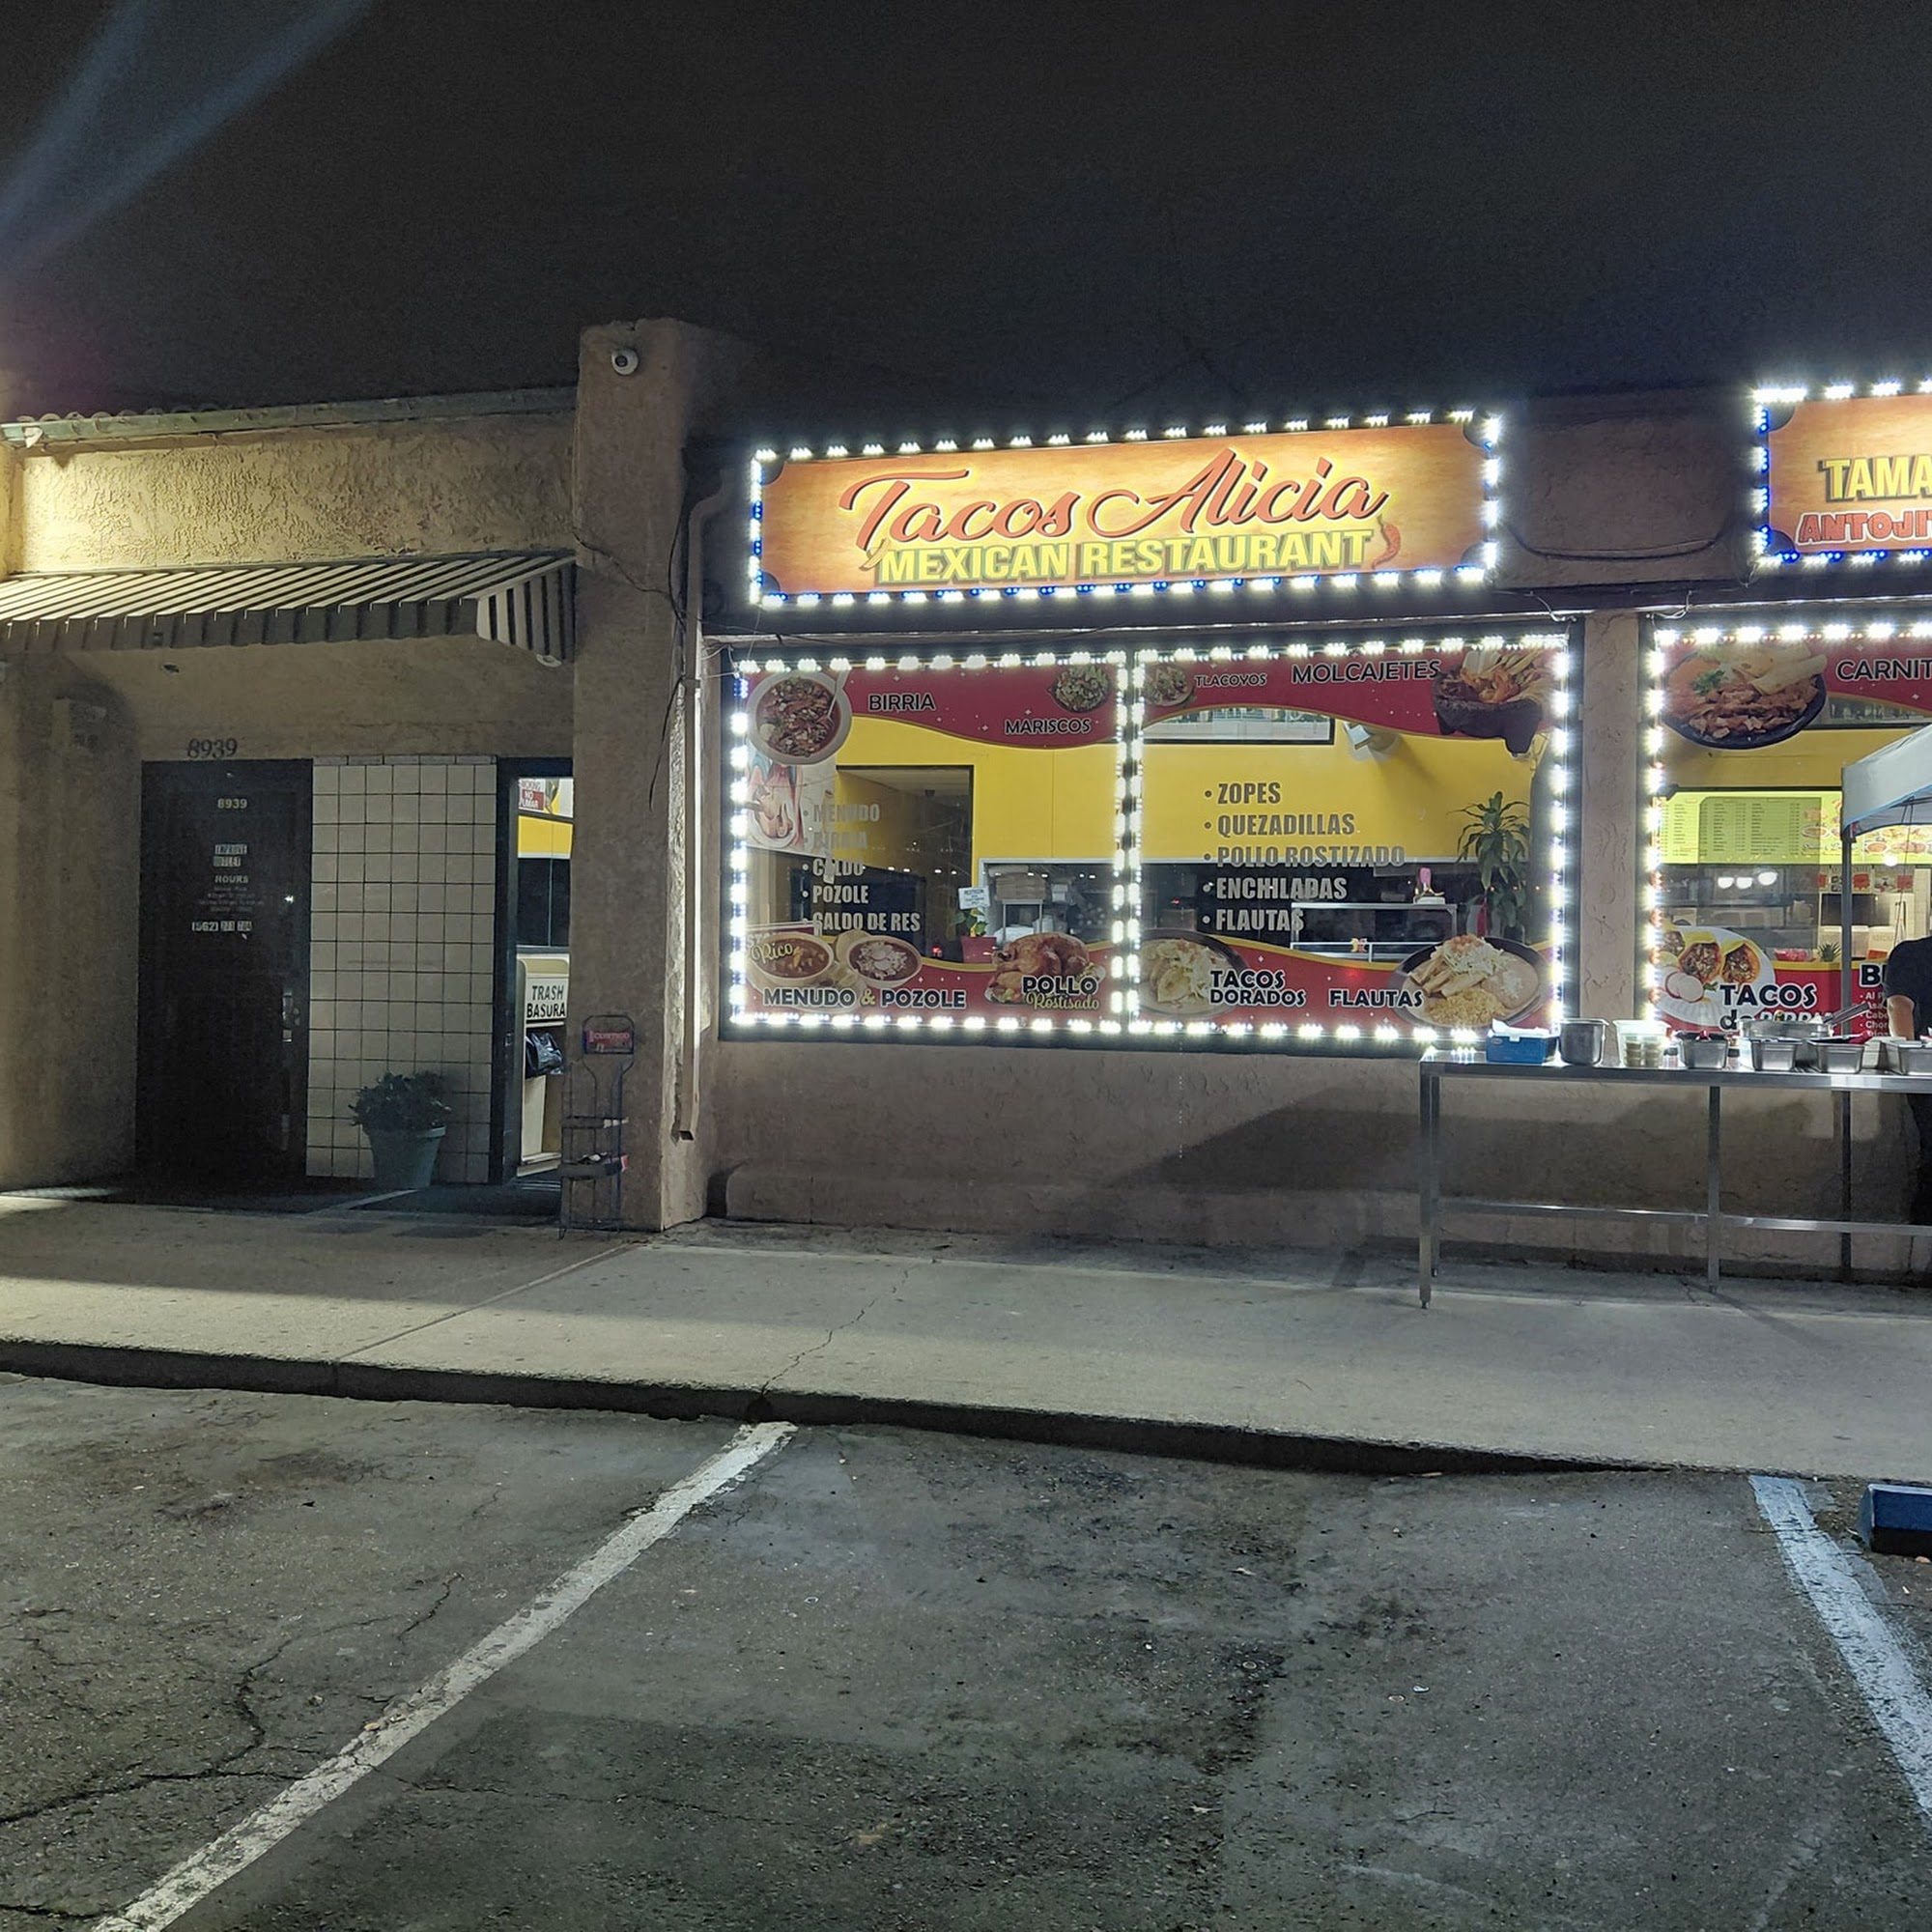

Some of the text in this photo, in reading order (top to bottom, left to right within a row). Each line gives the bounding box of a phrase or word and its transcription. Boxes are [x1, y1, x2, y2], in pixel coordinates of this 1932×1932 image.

[1819, 457, 1932, 502] TAMA
[838, 447, 1390, 554] Tacos Alicia
[877, 528, 1374, 586] MEXICAN RESTAURANT
[1292, 659, 1441, 684] MOLCAJETES
[869, 694, 935, 711] BIRRIA
[1006, 719, 1092, 735] MARISCOS
[187, 738, 238, 758] 8939
[217, 798, 248, 810] 8939
[1218, 782, 1281, 805] ZOPES
[1218, 814, 1355, 837] QUEZADILLAS
[1217, 845, 1406, 867] POLLO ROSTIZADO
[214, 875, 249, 884] HOURS
[1216, 877, 1348, 900] ENCHILADAS
[812, 885, 869, 904] POZOLE
[867, 912, 887, 931] DE
[891, 912, 921, 931] RES
[1216, 908, 1304, 932] FLAUTAS
[752, 942, 794, 964] Rico
[1021, 976, 1098, 996] POLLO
[1210, 970, 1286, 990] TACOS
[531, 985, 564, 1001] TRASH
[762, 987, 856, 1008] MENUDO
[880, 988, 966, 1009] POZOLE
[1209, 988, 1424, 1008] DORADOS FLAUTAS
[1719, 983, 1817, 1009] TACOS
[526, 1003, 565, 1018] BASURA
